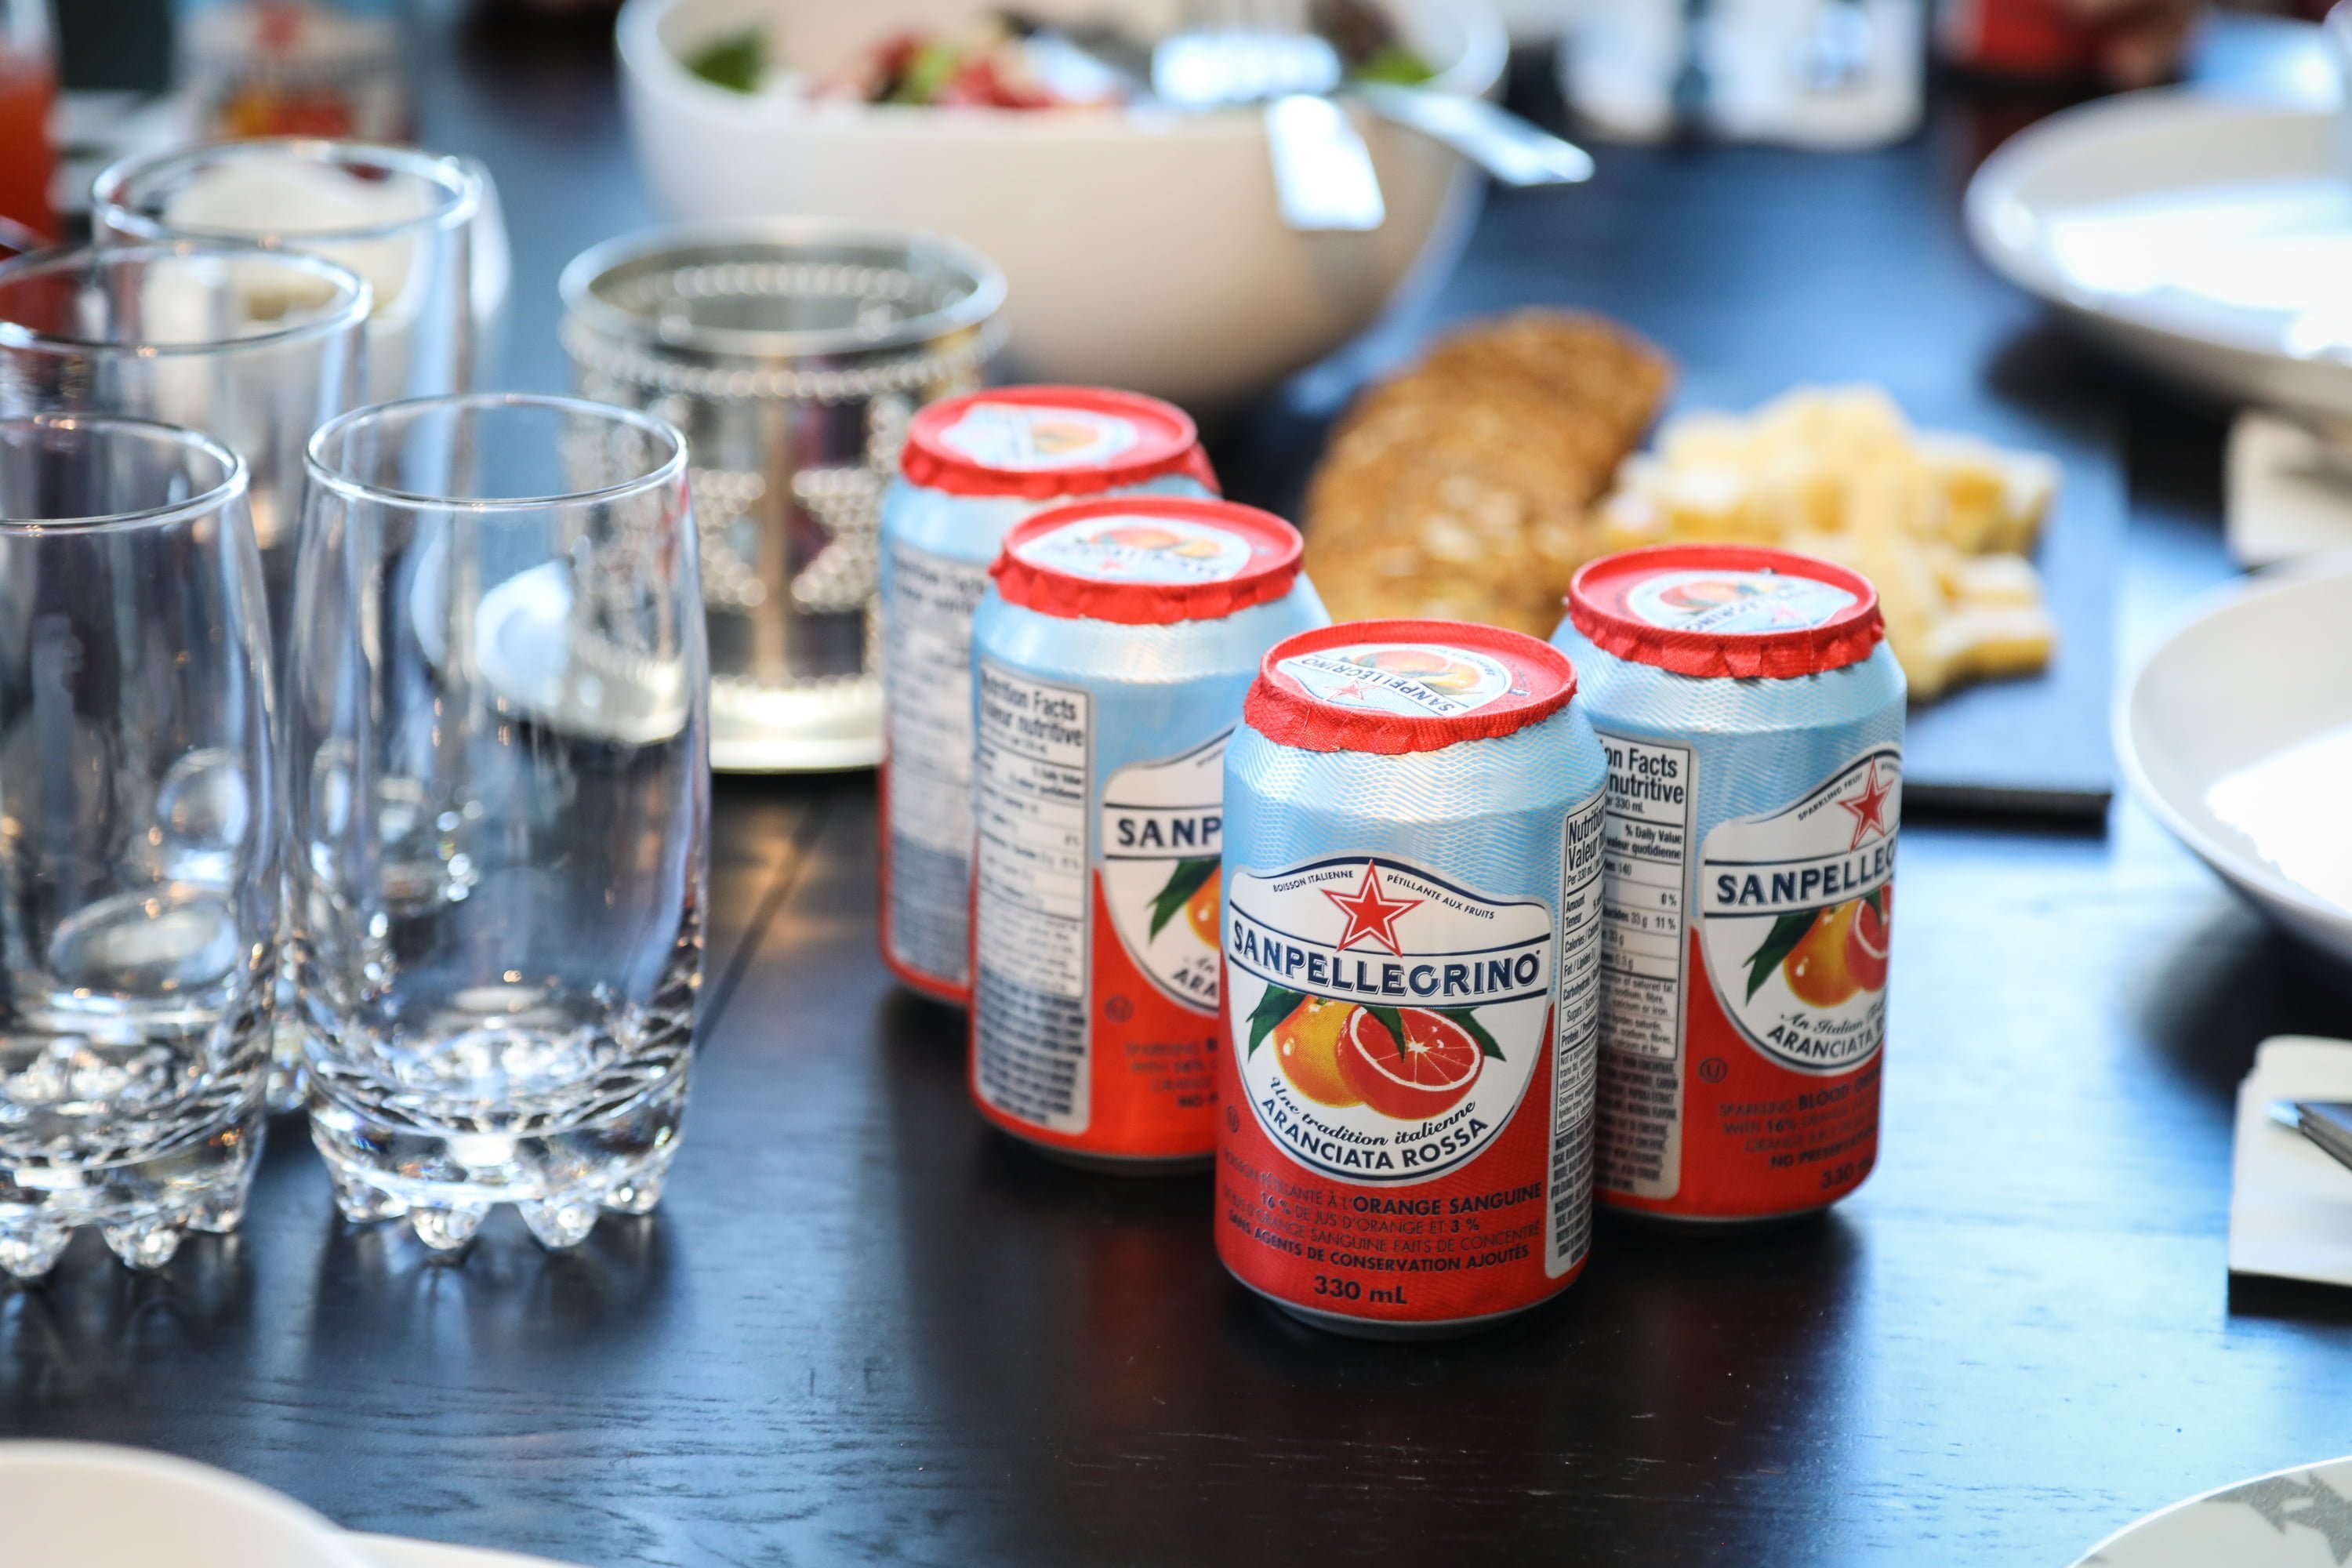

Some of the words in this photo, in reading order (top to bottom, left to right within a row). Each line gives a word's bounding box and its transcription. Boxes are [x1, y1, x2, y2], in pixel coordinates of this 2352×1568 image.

[1628, 747, 1678, 778] Facts
[1609, 771, 1684, 804] nutritive
[1615, 796, 1630, 810] 330
[1798, 787, 1842, 822] SPARKLING
[1632, 841, 1682, 859] quotidienne
[1635, 826, 1656, 843] Daily
[1658, 829, 1682, 844] Value
[1568, 837, 1598, 871] Valeur
[1272, 877, 1306, 893] BOISSON
[1308, 869, 1355, 884] ITALIENNE
[1567, 873, 1577, 887] Per
[1577, 867, 1587, 882] 330
[1717, 837, 1895, 906] SANPELLEG
[1386, 873, 1441, 901] PÉTILLANTE
[1442, 895, 1463, 911] AUX
[1463, 902, 1496, 920] FRUITS
[1566, 892, 1585, 913] Amount
[1566, 912, 1583, 929] Teneur
[1232, 919, 1541, 998] SANPELLEGRINO
[1565, 934, 1584, 953] Calories
[1564, 961, 1573, 978] Fat
[1567, 1005, 1582, 1022] Sugars
[1561, 1028, 1579, 1047] Protein
[1767, 1024, 1874, 1058] ARANCIATA
[1797, 1083, 1849, 1111] BLOOD
[1262, 1098, 1395, 1169] ARANCIATA
[1401, 1117, 1490, 1168] ROSSA
[1301, 1113, 1389, 1146] tradition
[1394, 1100, 1477, 1145] italienne
[1770, 1153, 1794, 1168] NO
[1260, 1191, 1275, 1209] 16
[1279, 1197, 1291, 1216] %
[1295, 1204, 1310, 1222] DE
[1314, 1210, 1337, 1227] JUS
[1342, 1216, 1424, 1235] D'ORANGE
[1429, 1220, 1446, 1235] ET
[1450, 1219, 1460, 1234] 3
[1465, 1218, 1480, 1232] %
[1449, 1182, 1542, 1215] SANGUINE
[1254, 1226, 1303, 1256] AGENTS
[1307, 1246, 1325, 1262] DE
[1330, 1250, 1461, 1272] CONSERVATION
[1465, 1243, 1530, 1269] AJOUTÉS
[1310, 1228, 1387, 1253] SANGUINE
[1393, 1238, 1432, 1254] FAITS
[1437, 1238, 1455, 1253] DE
[1460, 1218, 1541, 1251] CONCENTRÉ
[1313, 1274, 1361, 1301] 330
[1369, 1285, 1408, 1305] mL
